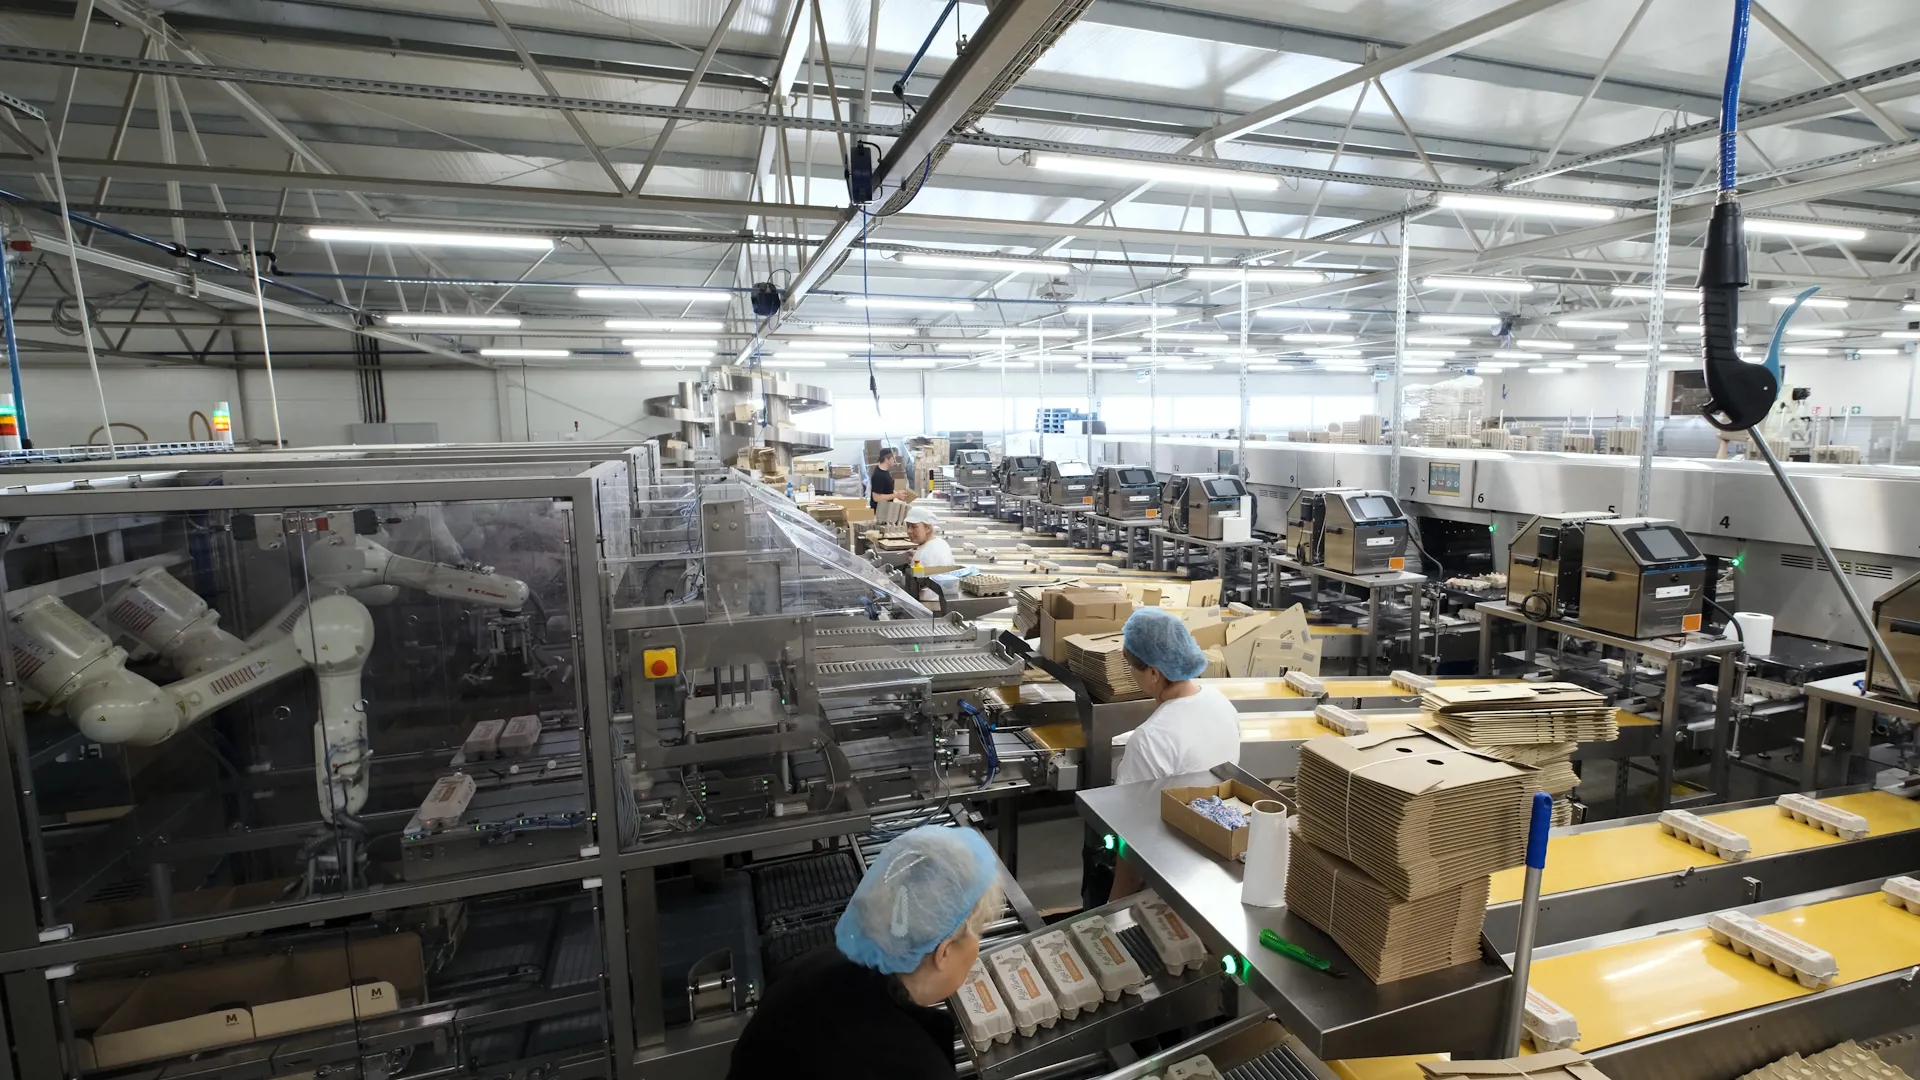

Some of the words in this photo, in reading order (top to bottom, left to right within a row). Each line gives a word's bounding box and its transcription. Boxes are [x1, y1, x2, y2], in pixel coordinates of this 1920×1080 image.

[1174, 464, 1180, 472] 12
[1290, 475, 1295, 484] 9
[1336, 479, 1341, 488] 8
[1410, 486, 1416, 497] 7
[1477, 493, 1485, 504] 6
[1608, 505, 1616, 514] 5
[1719, 515, 1731, 529] 4
[371, 987, 383, 997] M
[226, 1013, 238, 1023] M
